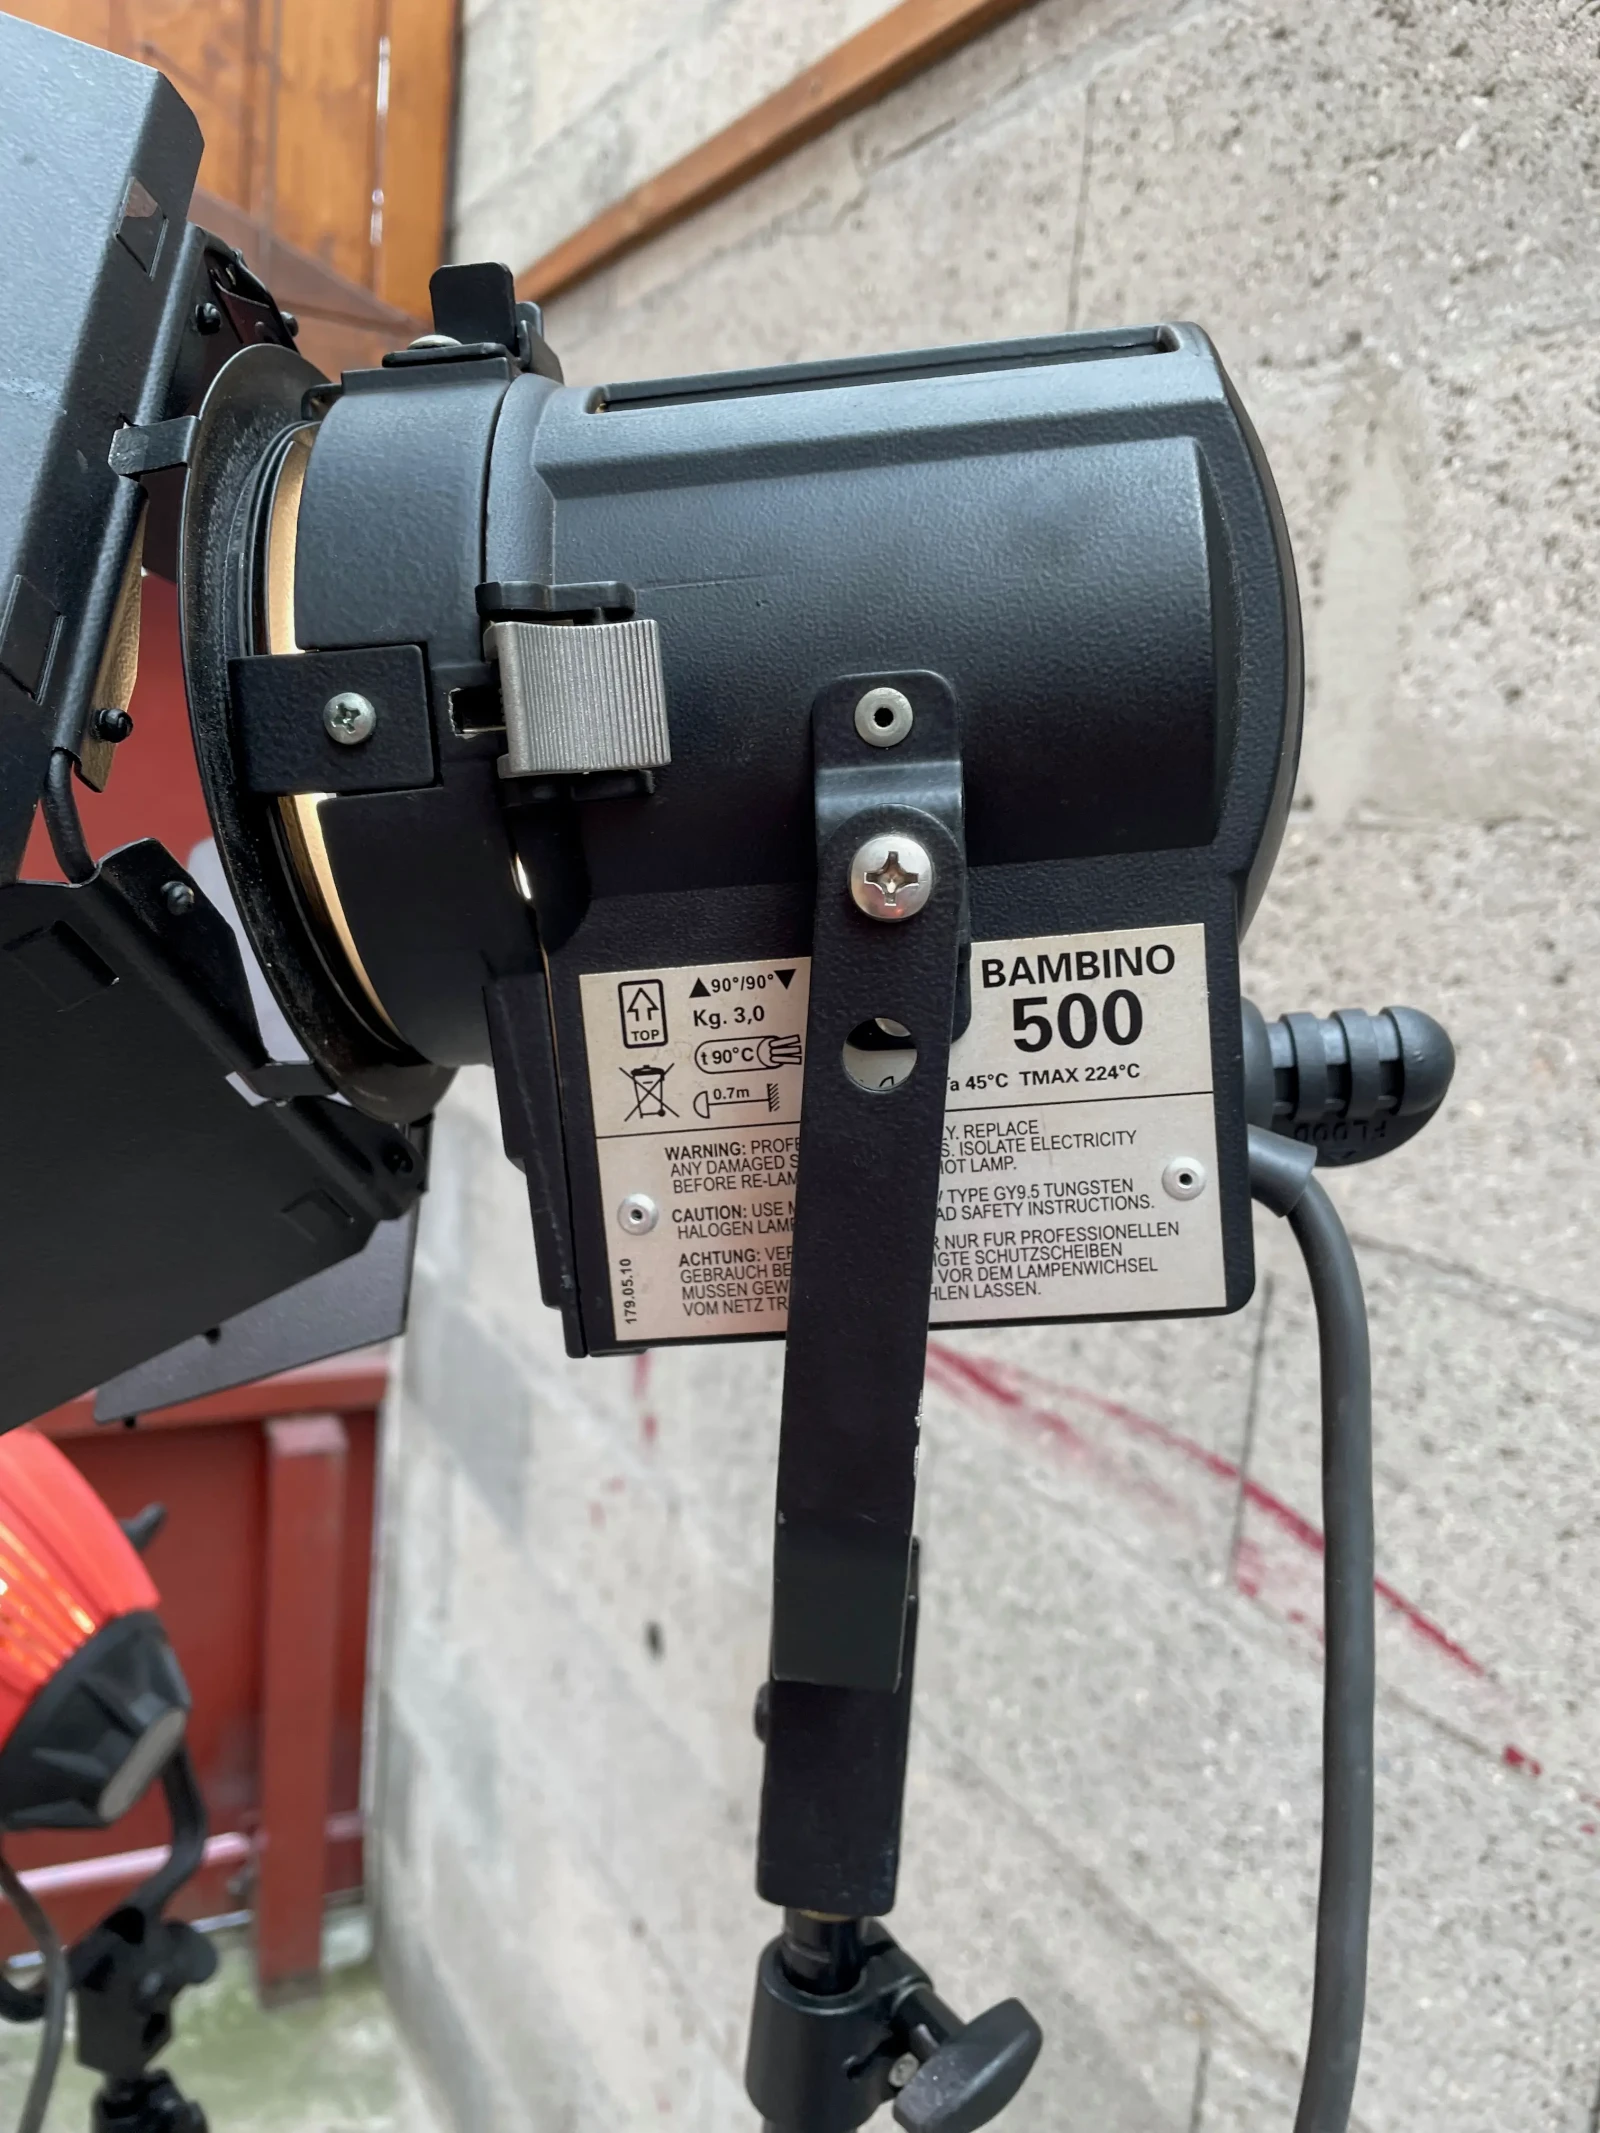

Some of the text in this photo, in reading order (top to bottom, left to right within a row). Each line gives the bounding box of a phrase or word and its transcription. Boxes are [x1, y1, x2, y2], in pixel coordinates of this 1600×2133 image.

[981, 944, 1175, 988] BAMBINO
[631, 1029, 660, 1042] TOP
[693, 1005, 765, 1030] Kg. 3,0
[1012, 989, 1143, 1052] 500
[713, 1087, 750, 1100] 0.7m
[965, 1073, 1009, 1090] 45°C
[1019, 1067, 1079, 1086] TMAX
[1085, 1063, 1141, 1082] 224°C
[665, 1141, 747, 1161] WARNING:
[964, 1120, 1039, 1139] REPLACE
[670, 1161, 703, 1177] ANY
[707, 1155, 785, 1175] DAMAGED
[959, 1136, 1026, 1157] ISOLATE
[1030, 1130, 1137, 1151] ELECTRICITY
[673, 1175, 737, 1194] BEFORE
[970, 1156, 1017, 1173] LAMP.
[672, 1204, 747, 1223] CAUTION:
[752, 1201, 784, 1217] USE
[947, 1187, 989, 1204] TYPE
[994, 1183, 1040, 1201] GY9.5
[1043, 1178, 1134, 1198] TUNGSTEN
[677, 1221, 753, 1240] HALOGEN
[961, 1202, 1023, 1220] SAFETY
[1027, 1194, 1155, 1216] INSTRUCTIONS.
[678, 1248, 761, 1268] ACHTUNG:
[945, 1233, 979, 1249] NUR
[984, 1231, 1017, 1247] FUR
[1020, 1221, 1180, 1246] PROFESSIONELLEN
[680, 1263, 768, 1284] GEBRAUCH
[975, 1242, 1122, 1265] SCHUTZSCHEIBEN
[619, 1258, 637, 1324] 179.05.10
[682, 1282, 748, 1300] MUSSEN
[938, 1267, 973, 1283] VOR
[978, 1265, 1013, 1281] DEM
[1017, 1257, 1158, 1280] LAMPENWICHSEL
[683, 1301, 719, 1317] VOM
[723, 1297, 764, 1314] NETZ
[974, 1281, 1042, 1299] LASSEN.
